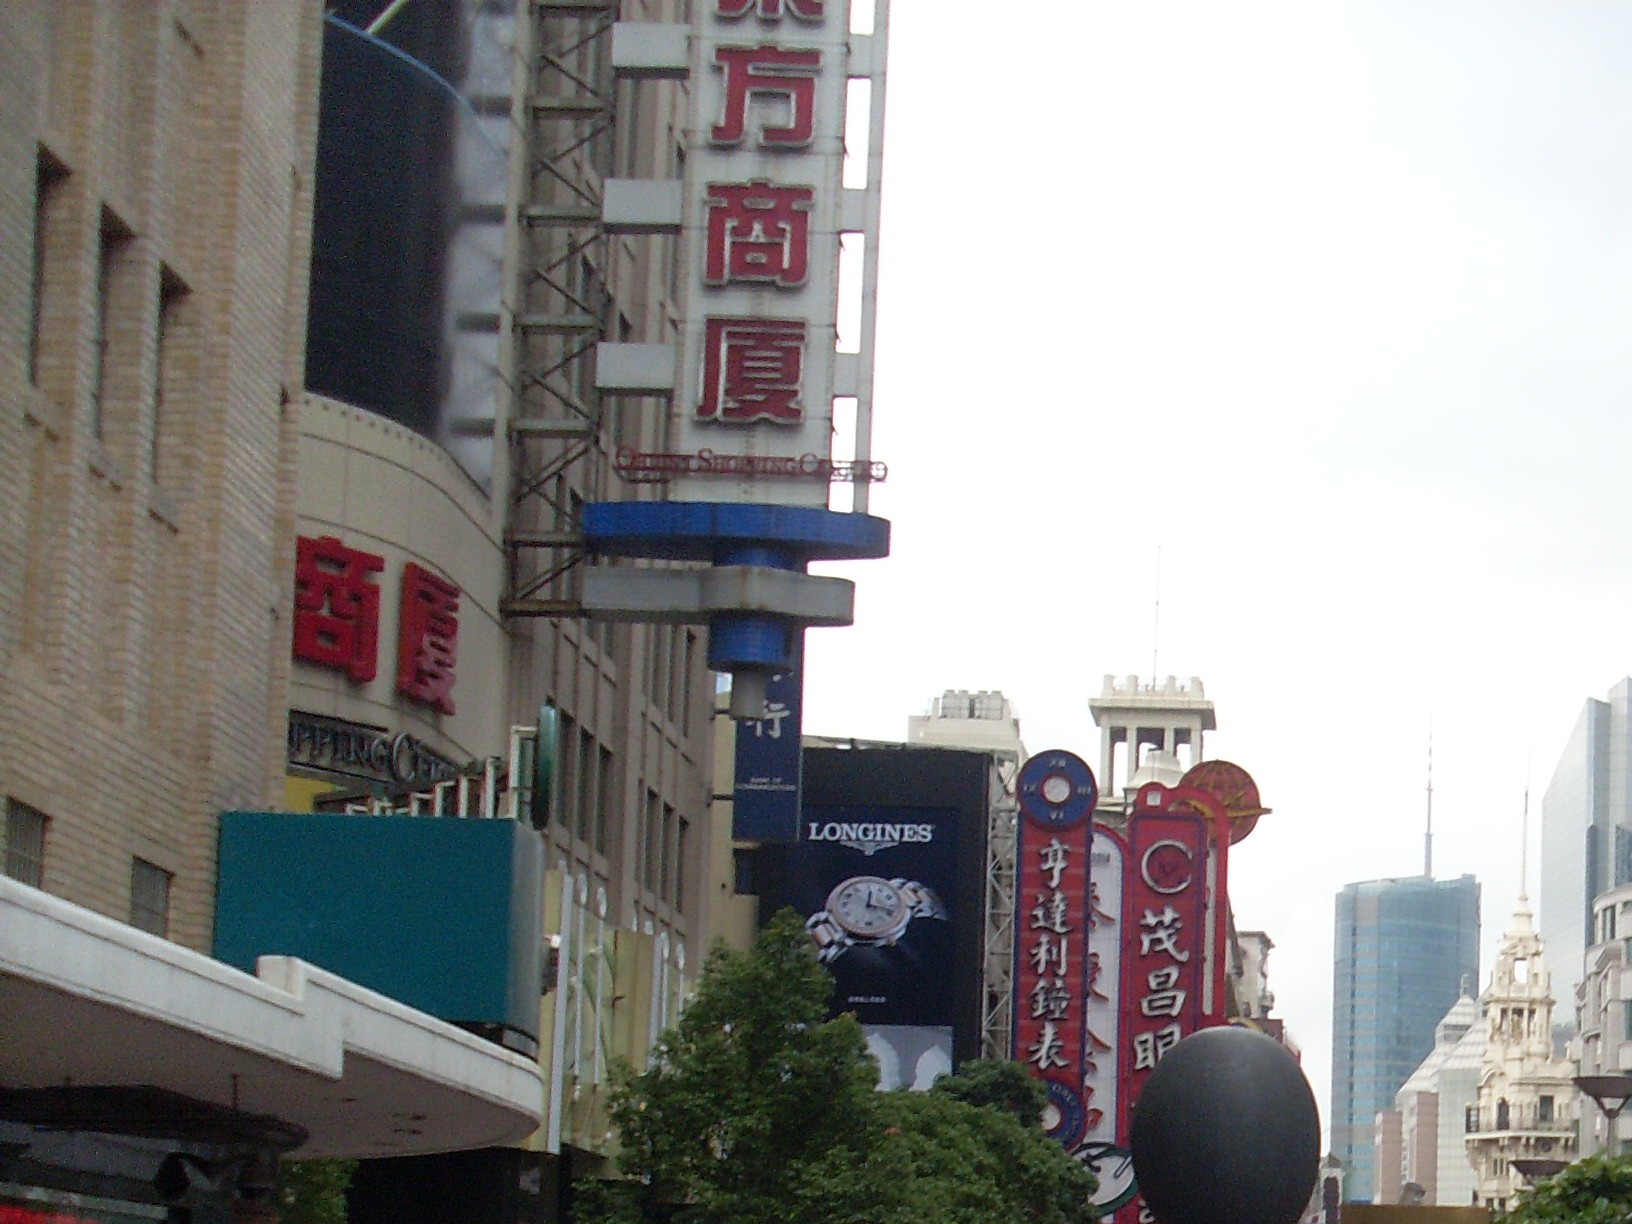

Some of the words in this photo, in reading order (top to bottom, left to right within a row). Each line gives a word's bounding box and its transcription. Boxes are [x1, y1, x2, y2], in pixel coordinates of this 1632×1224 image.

[696, 0, 824, 425] 方商厦
[808, 821, 934, 843] LONGINES
